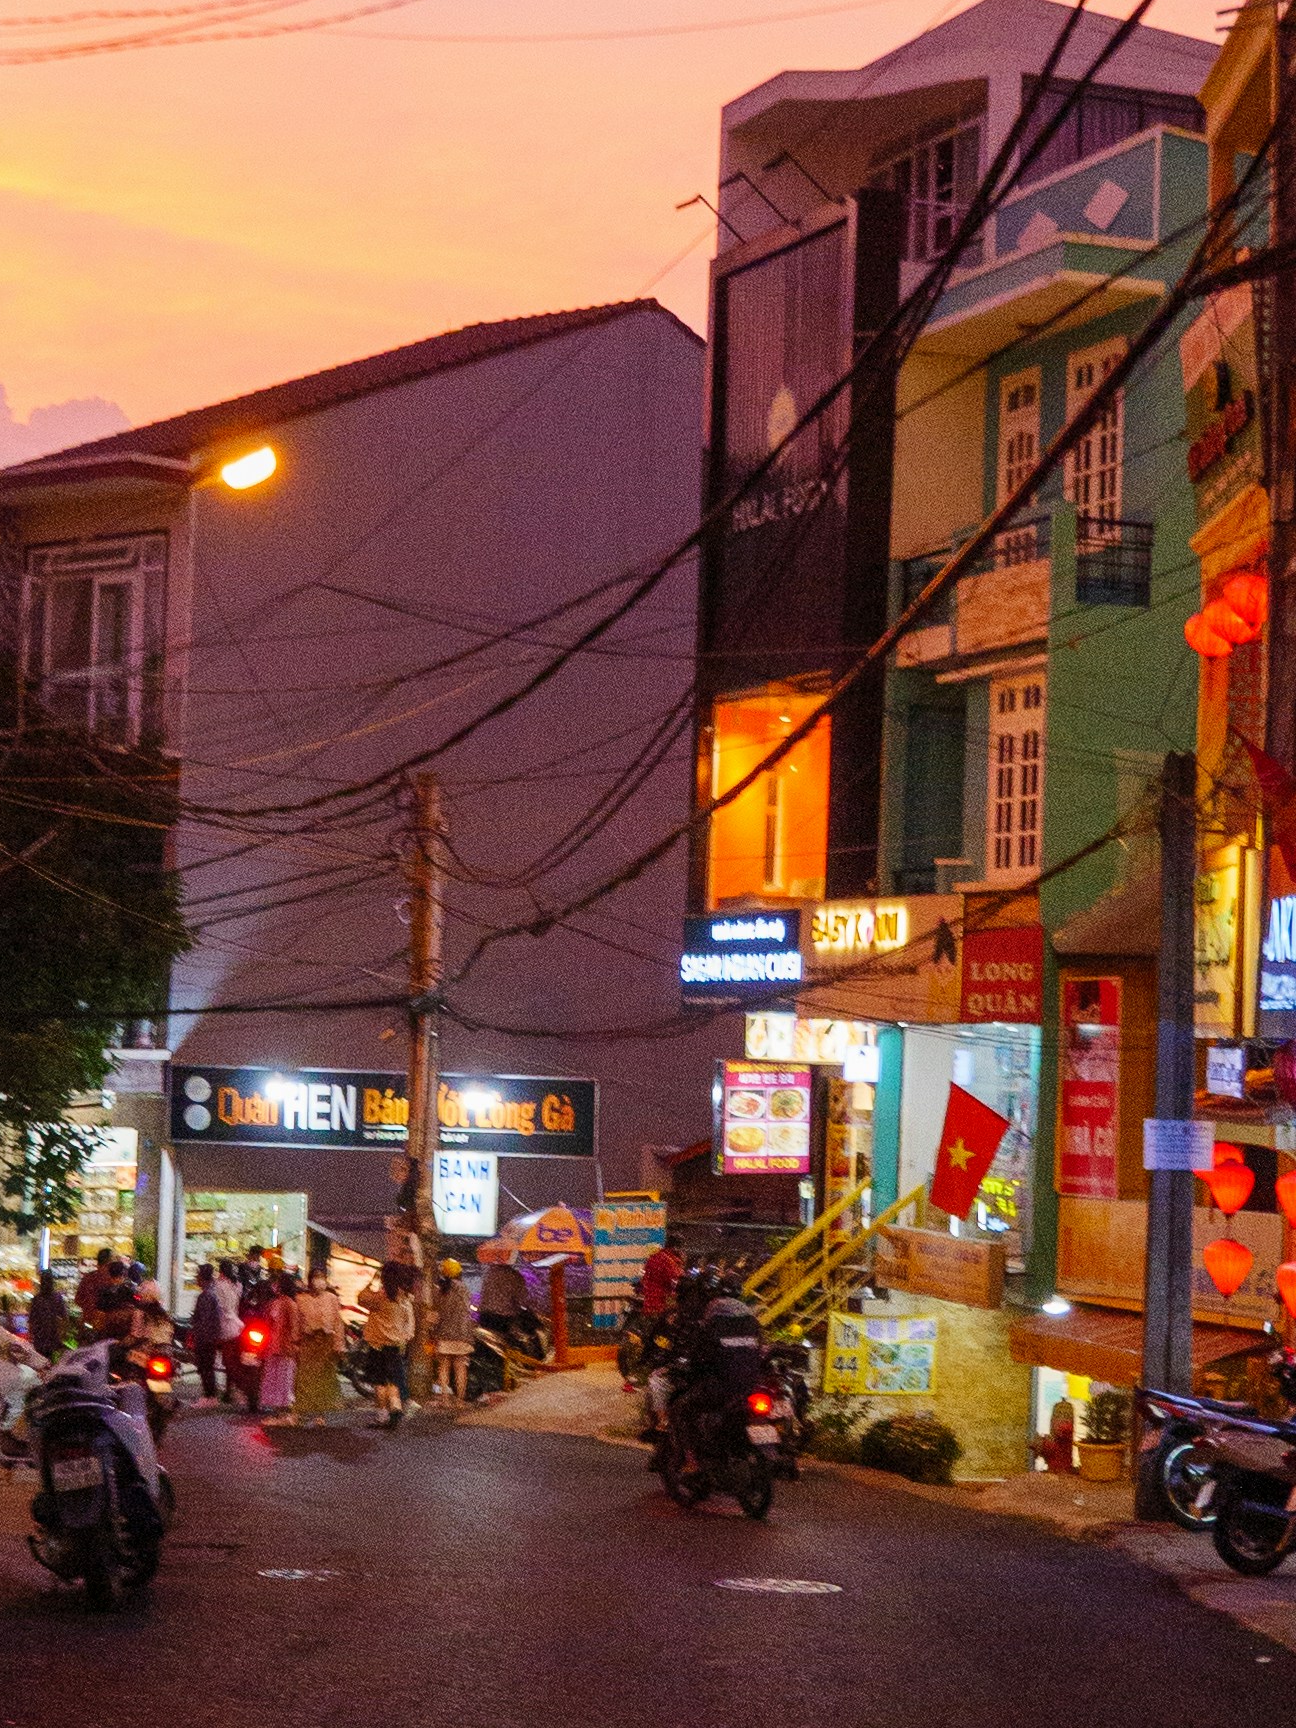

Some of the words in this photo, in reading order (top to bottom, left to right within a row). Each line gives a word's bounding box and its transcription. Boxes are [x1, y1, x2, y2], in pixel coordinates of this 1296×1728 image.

[969, 959, 1035, 983] LONG
[363, 1087, 410, 1125] Bán
[541, 1092, 576, 1132] Gà
